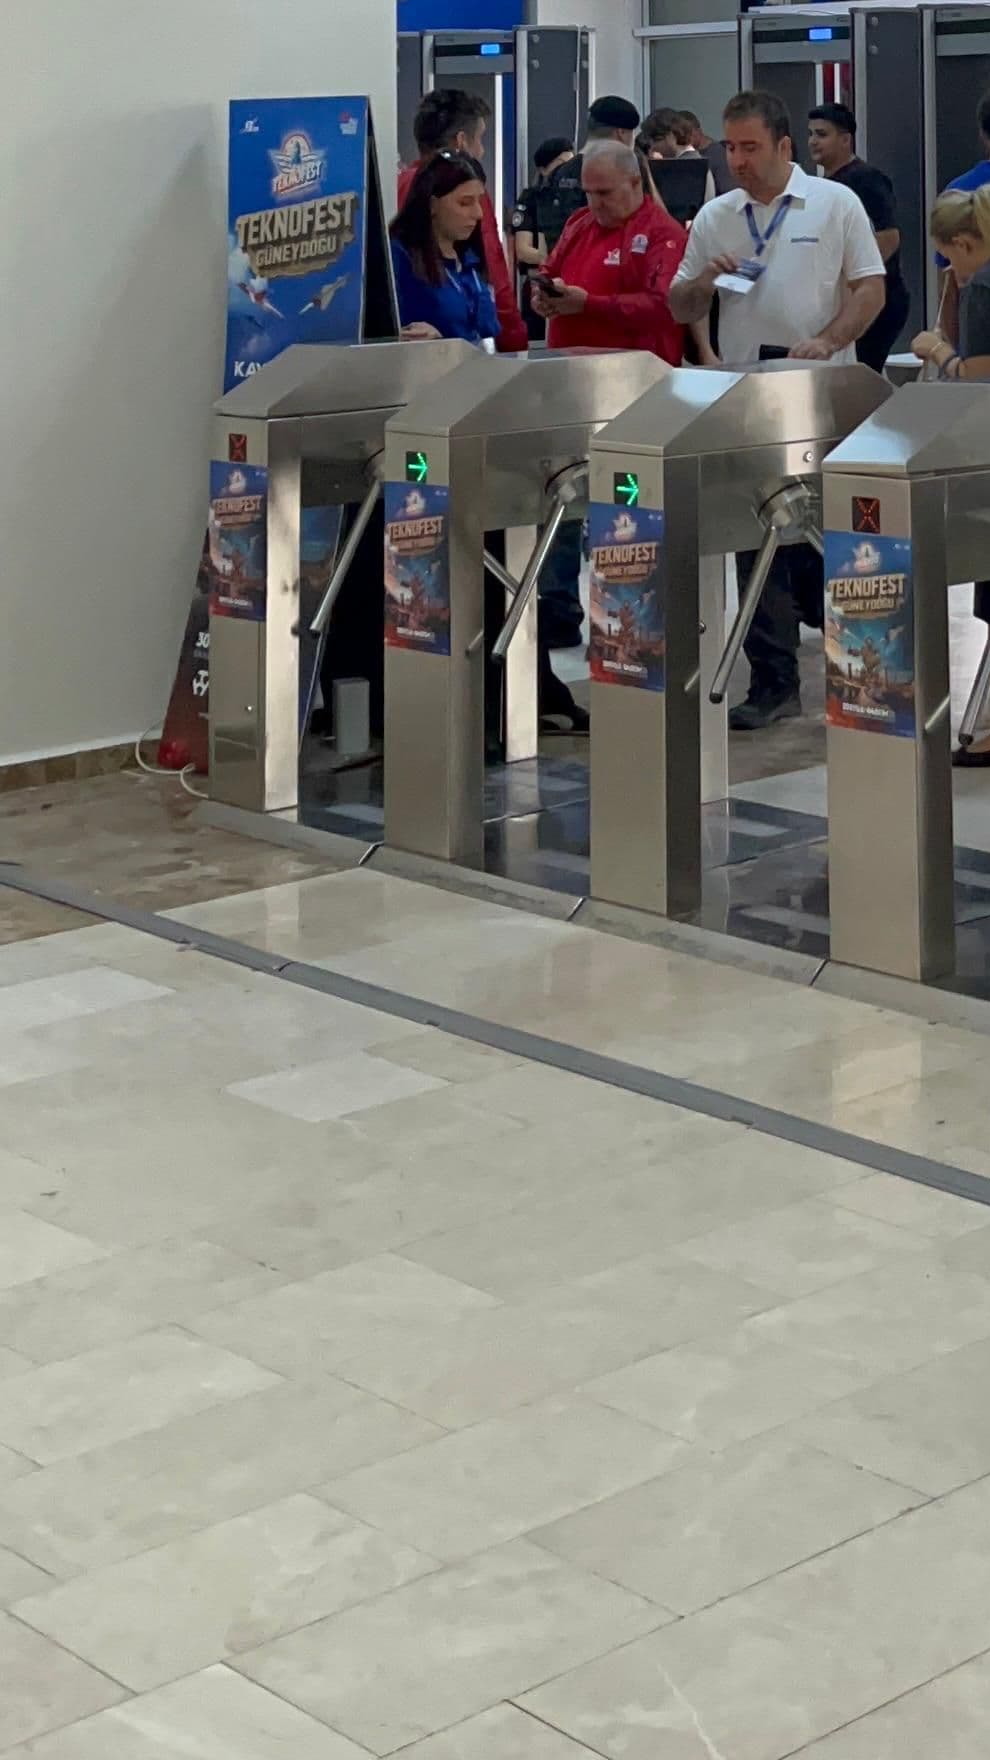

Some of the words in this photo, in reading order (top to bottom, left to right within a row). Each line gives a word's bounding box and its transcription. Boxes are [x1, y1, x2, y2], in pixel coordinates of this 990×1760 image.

[236, 193, 357, 245] TEKNOFEST
[255, 235, 337, 268] GÜNEYDOĞU
[592, 541, 656, 565] TEKNOFEST
[827, 573, 905, 600] TEKNOFEST
